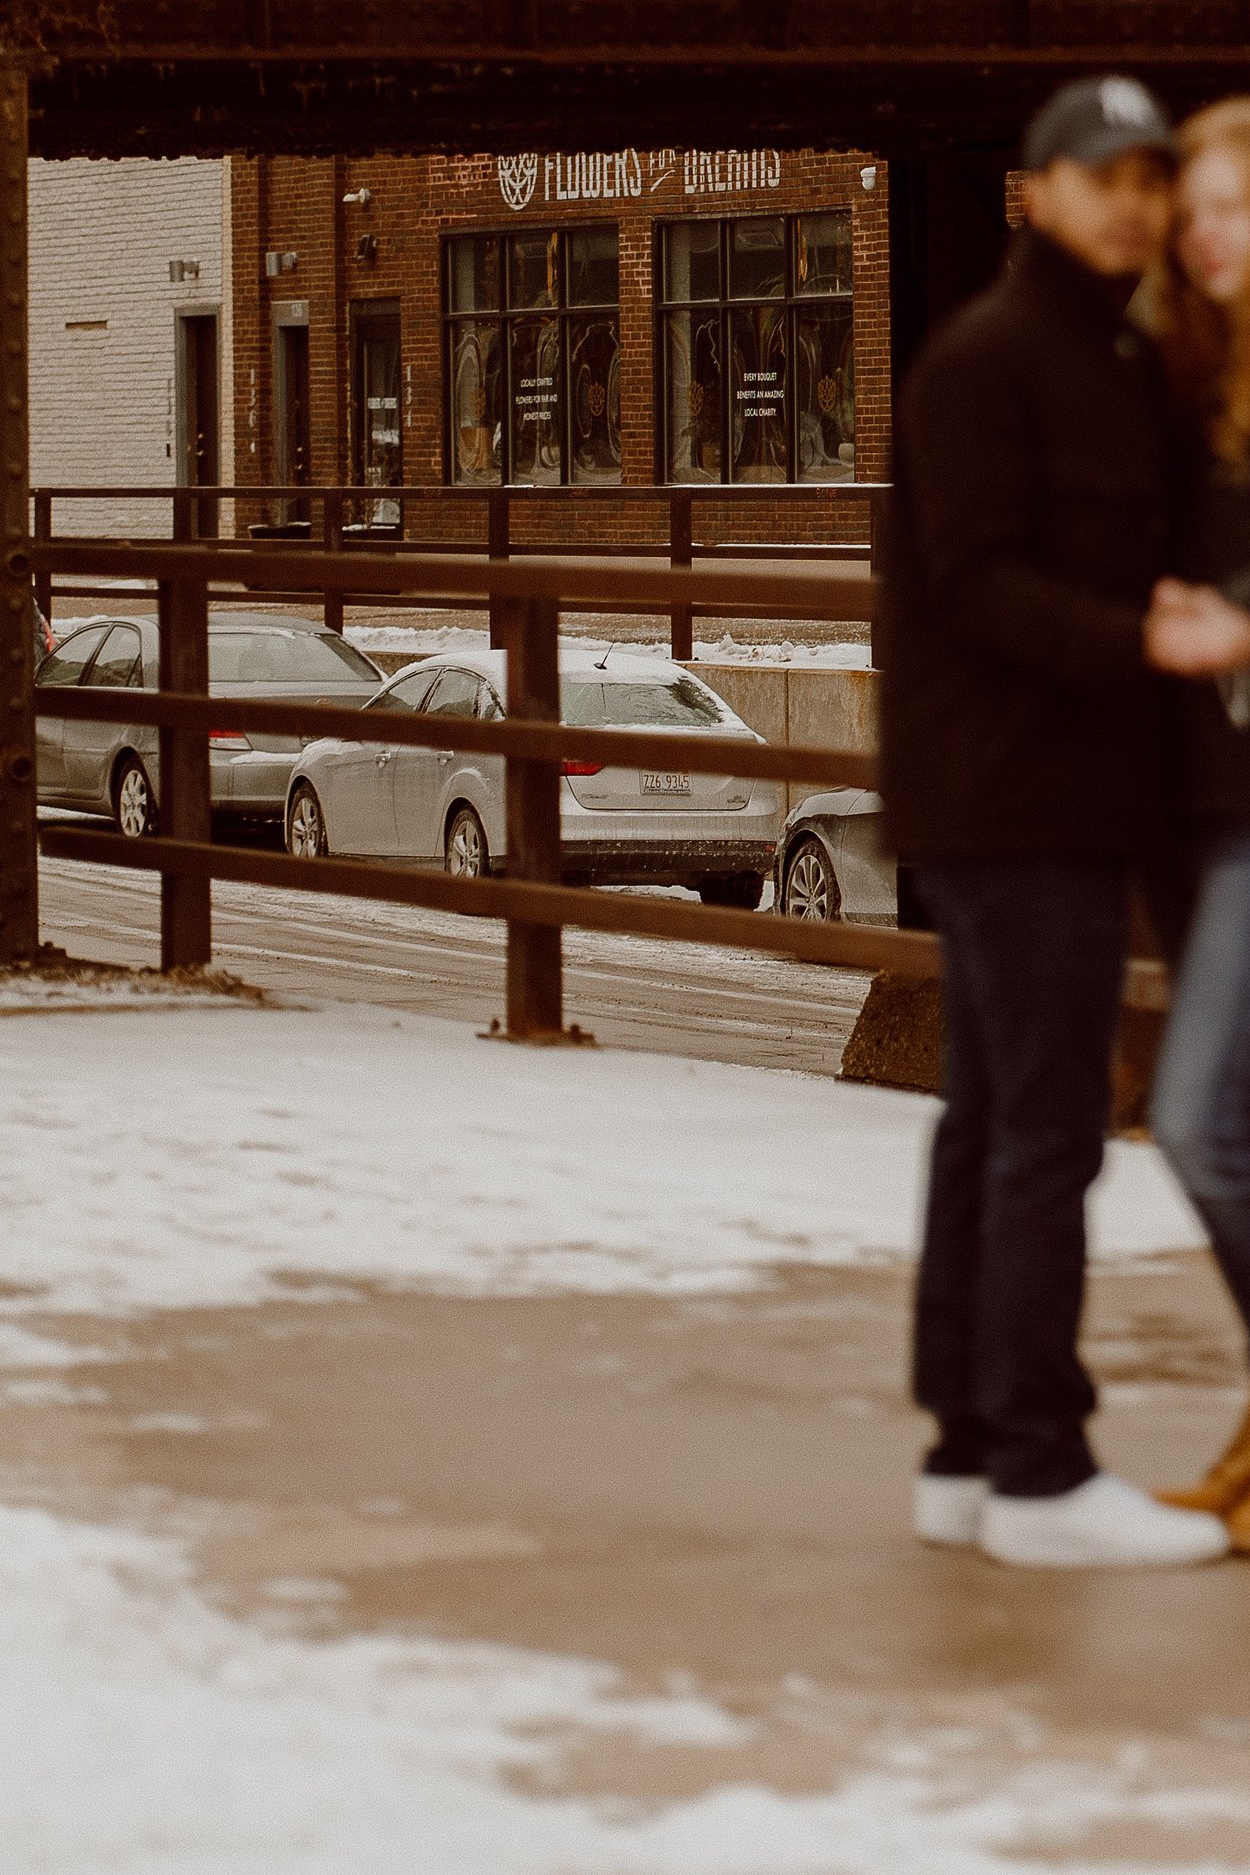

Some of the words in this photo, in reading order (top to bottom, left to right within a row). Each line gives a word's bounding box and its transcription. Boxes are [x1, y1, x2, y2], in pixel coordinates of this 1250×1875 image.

[744, 373, 756, 381] EVERY
[758, 372, 777, 381] BOUQUET
[737, 391, 756, 399] BENEFITS
[756, 390, 764, 398] AN
[764, 390, 784, 398] AMAZING
[745, 408, 758, 416] LOCAL
[643, 774, 661, 789] ZZ6
[666, 774, 690, 789] 9345
